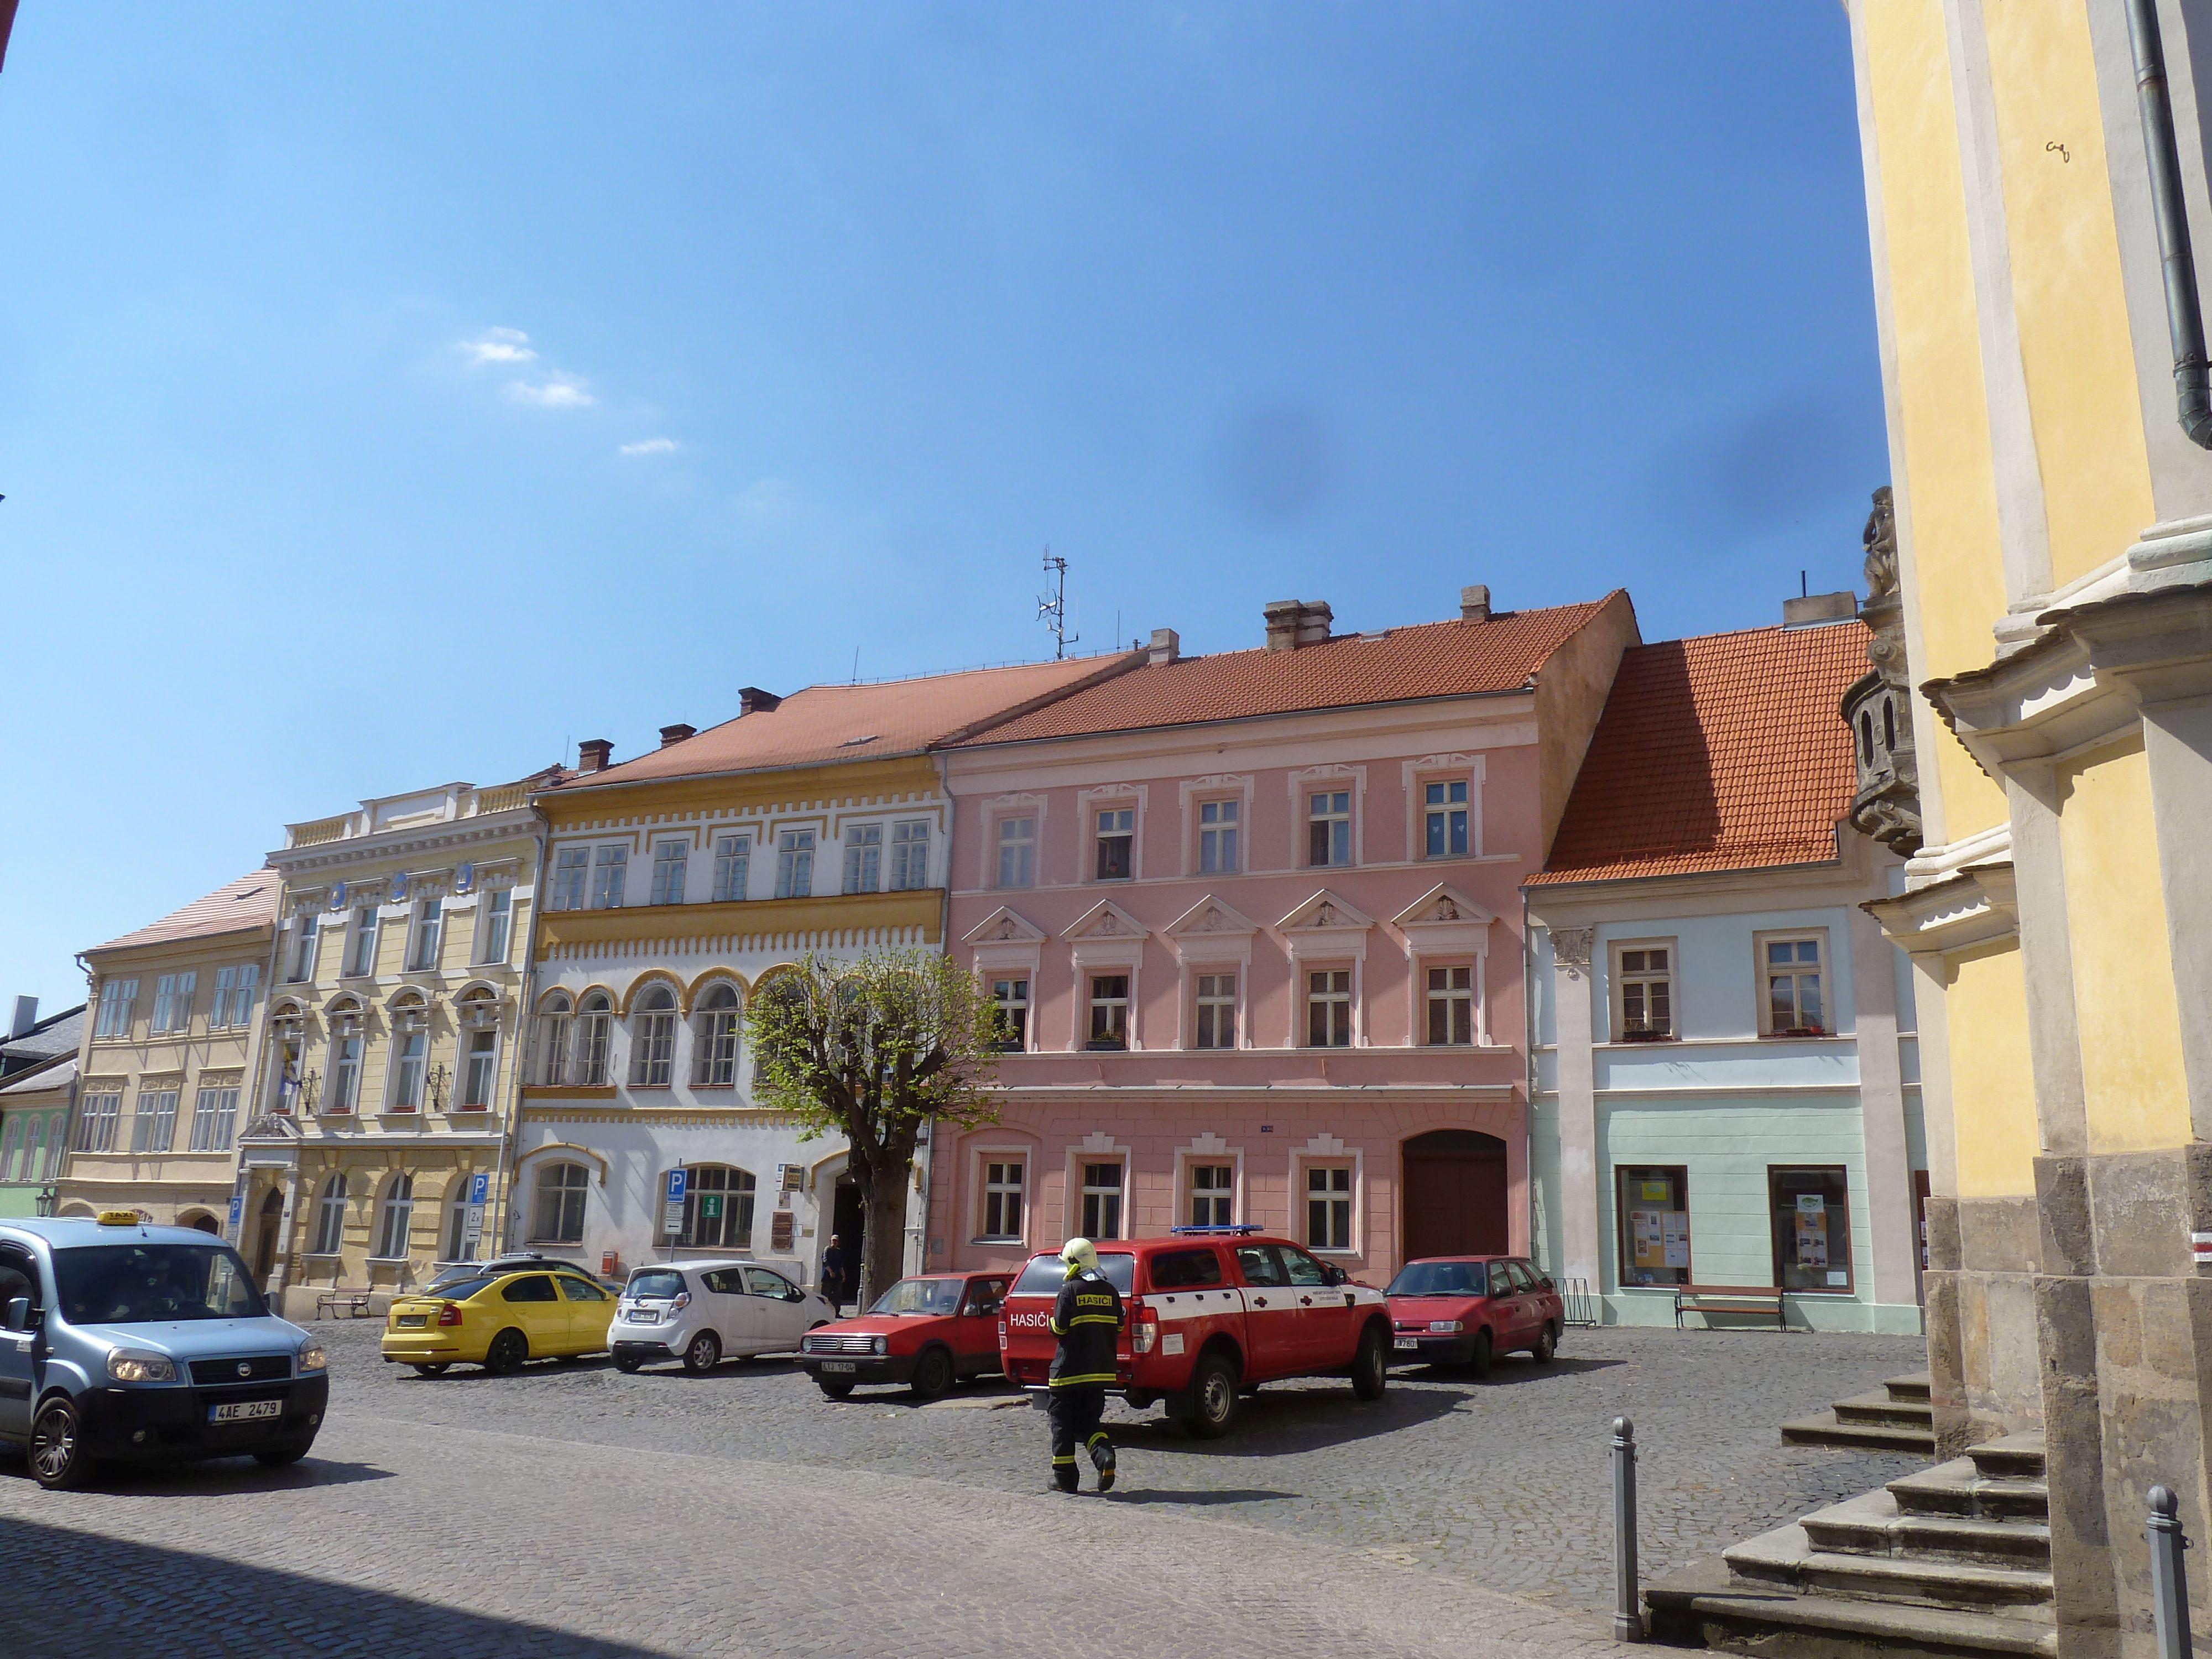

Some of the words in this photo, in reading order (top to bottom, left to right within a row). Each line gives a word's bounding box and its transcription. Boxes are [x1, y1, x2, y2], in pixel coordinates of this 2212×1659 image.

[475, 1177, 484, 1195] P
[671, 1173, 682, 1192] P
[232, 1201, 239, 1216] P
[1010, 1311, 1049, 1327] HASIČI
[218, 1406, 240, 1418] 4AE
[249, 1402, 276, 1416] 2479
